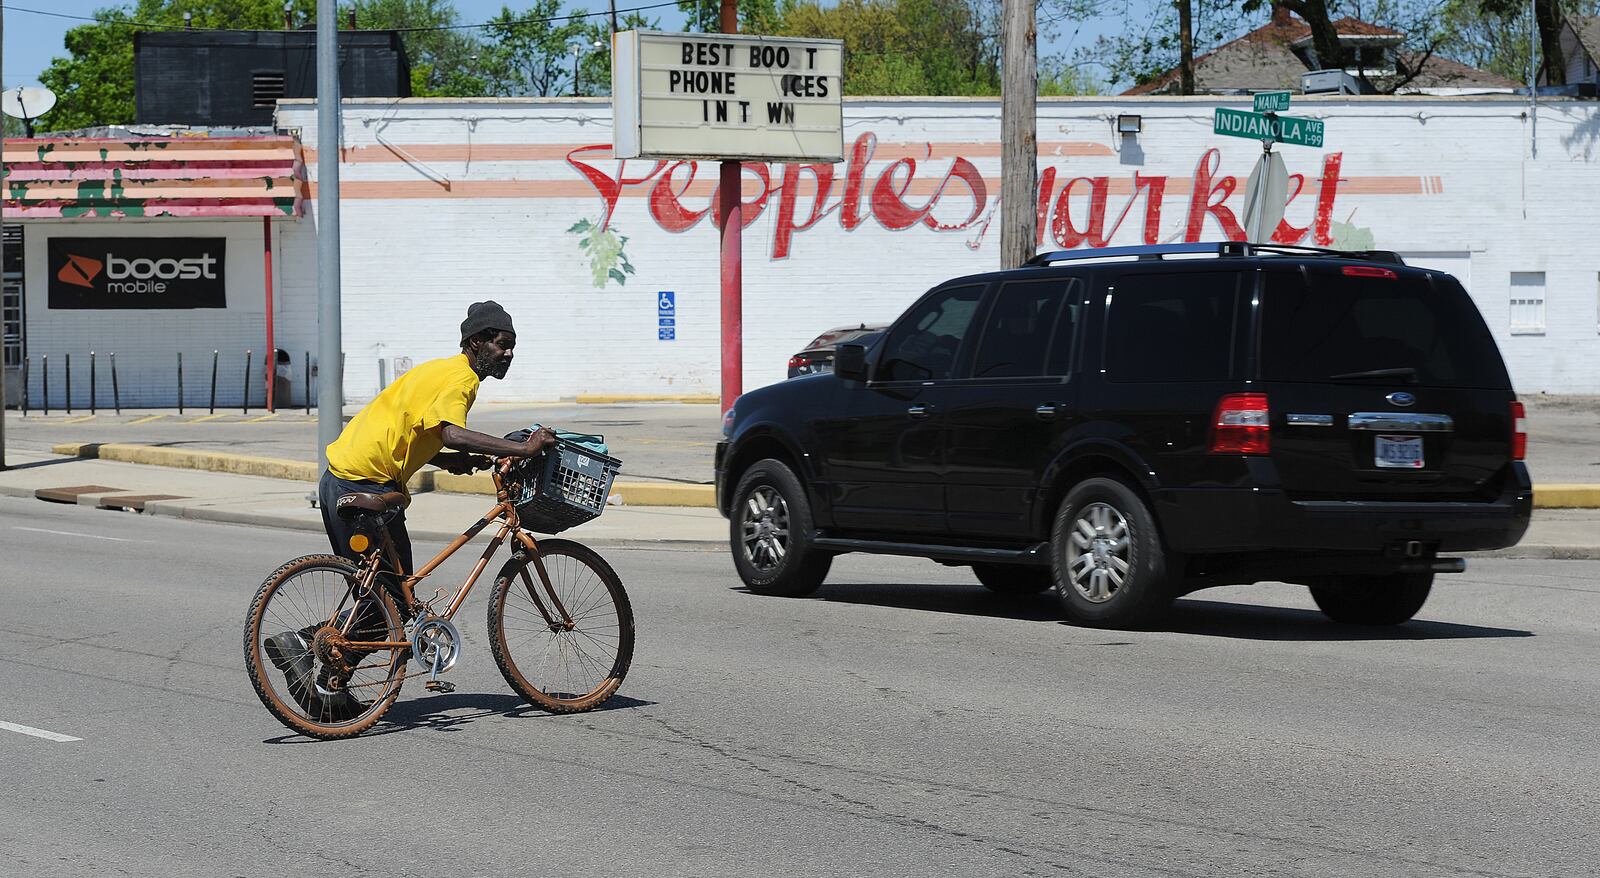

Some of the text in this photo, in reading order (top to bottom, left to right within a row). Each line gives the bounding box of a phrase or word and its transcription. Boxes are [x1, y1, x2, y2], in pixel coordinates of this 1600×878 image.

[682, 42, 735, 66] BEST
[669, 70, 736, 94] PHONE
[703, 100, 728, 122] IN
[1257, 95, 1279, 110] MAIN
[1216, 112, 1322, 140] INDIANOLA AVE
[1304, 134, 1322, 146] 1-99
[106, 253, 216, 279] boost
[107, 280, 167, 293] mobile
